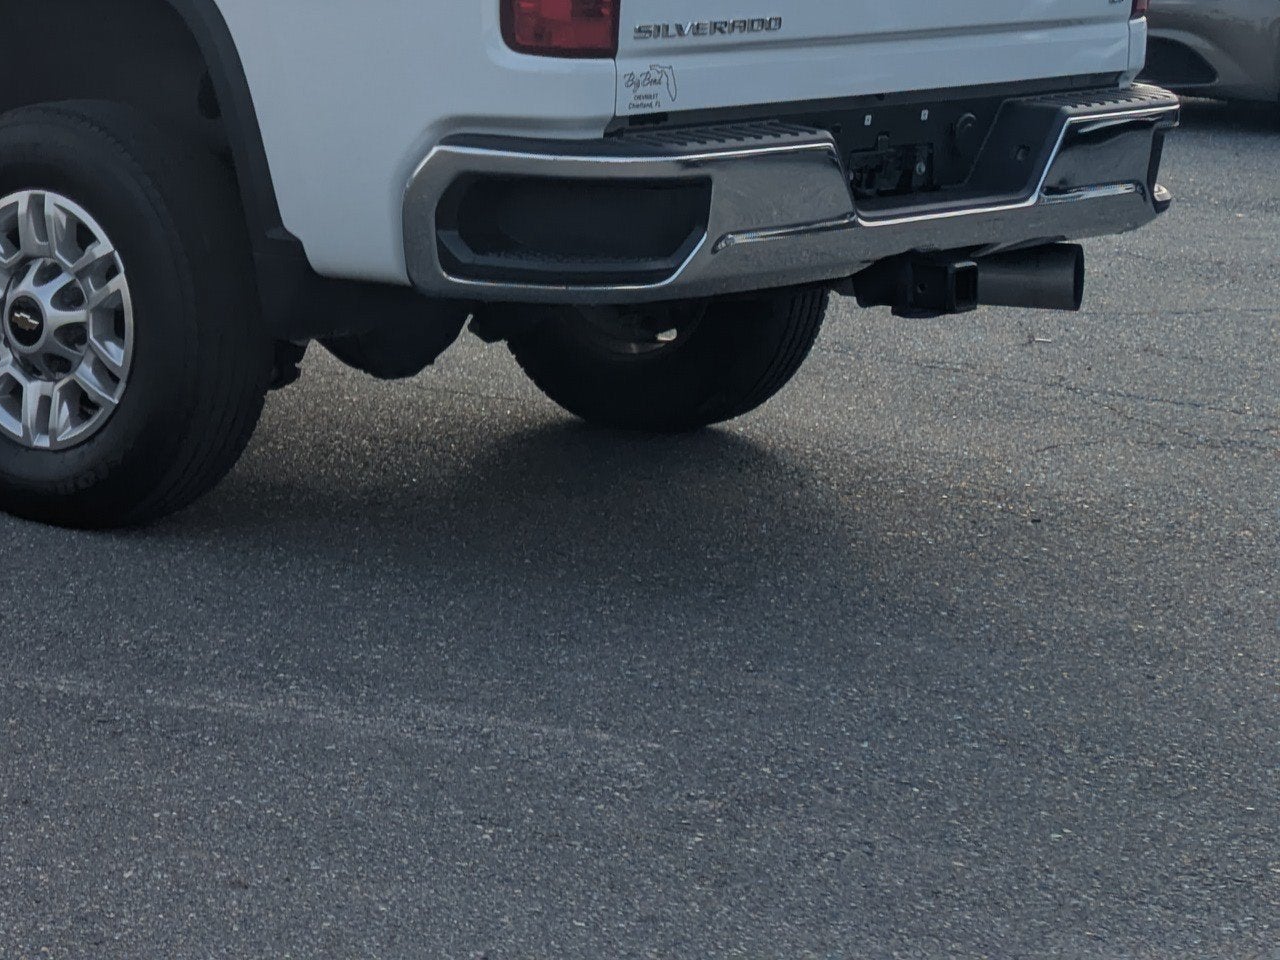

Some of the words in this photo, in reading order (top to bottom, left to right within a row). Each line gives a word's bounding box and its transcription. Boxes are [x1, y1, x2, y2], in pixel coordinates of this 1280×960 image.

[633, 16, 782, 40] SILVERADO
[624, 71, 640, 93] Big
[640, 69, 663, 87] Bend
